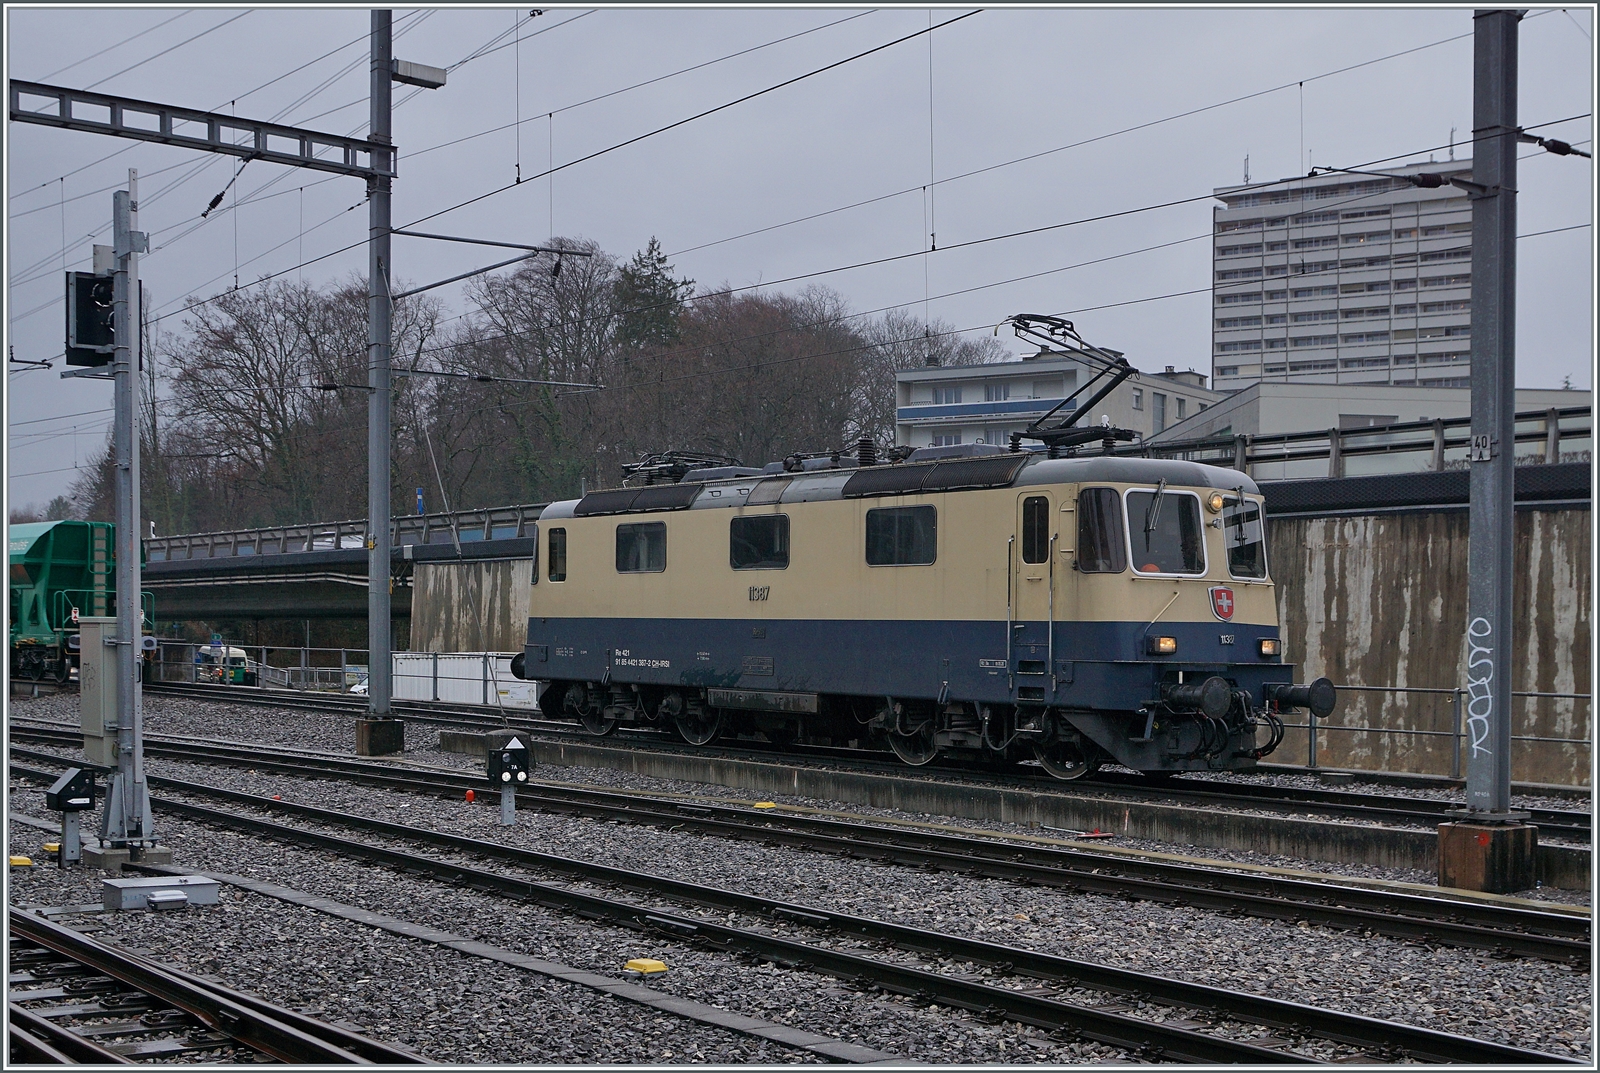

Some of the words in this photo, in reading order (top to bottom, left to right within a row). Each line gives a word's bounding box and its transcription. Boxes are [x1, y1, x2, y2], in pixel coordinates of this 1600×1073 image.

[1474, 435, 1488, 449] 40
[1478, 450, 1484, 460] A
[748, 585, 771, 601] 11387
[622, 649, 630, 657] 421
[615, 658, 620, 666] 91
[621, 658, 627, 666] 85
[627, 659, 638, 667] 4421
[638, 659, 651, 667] 387-2
[652, 660, 670, 669] CH-IRSI
